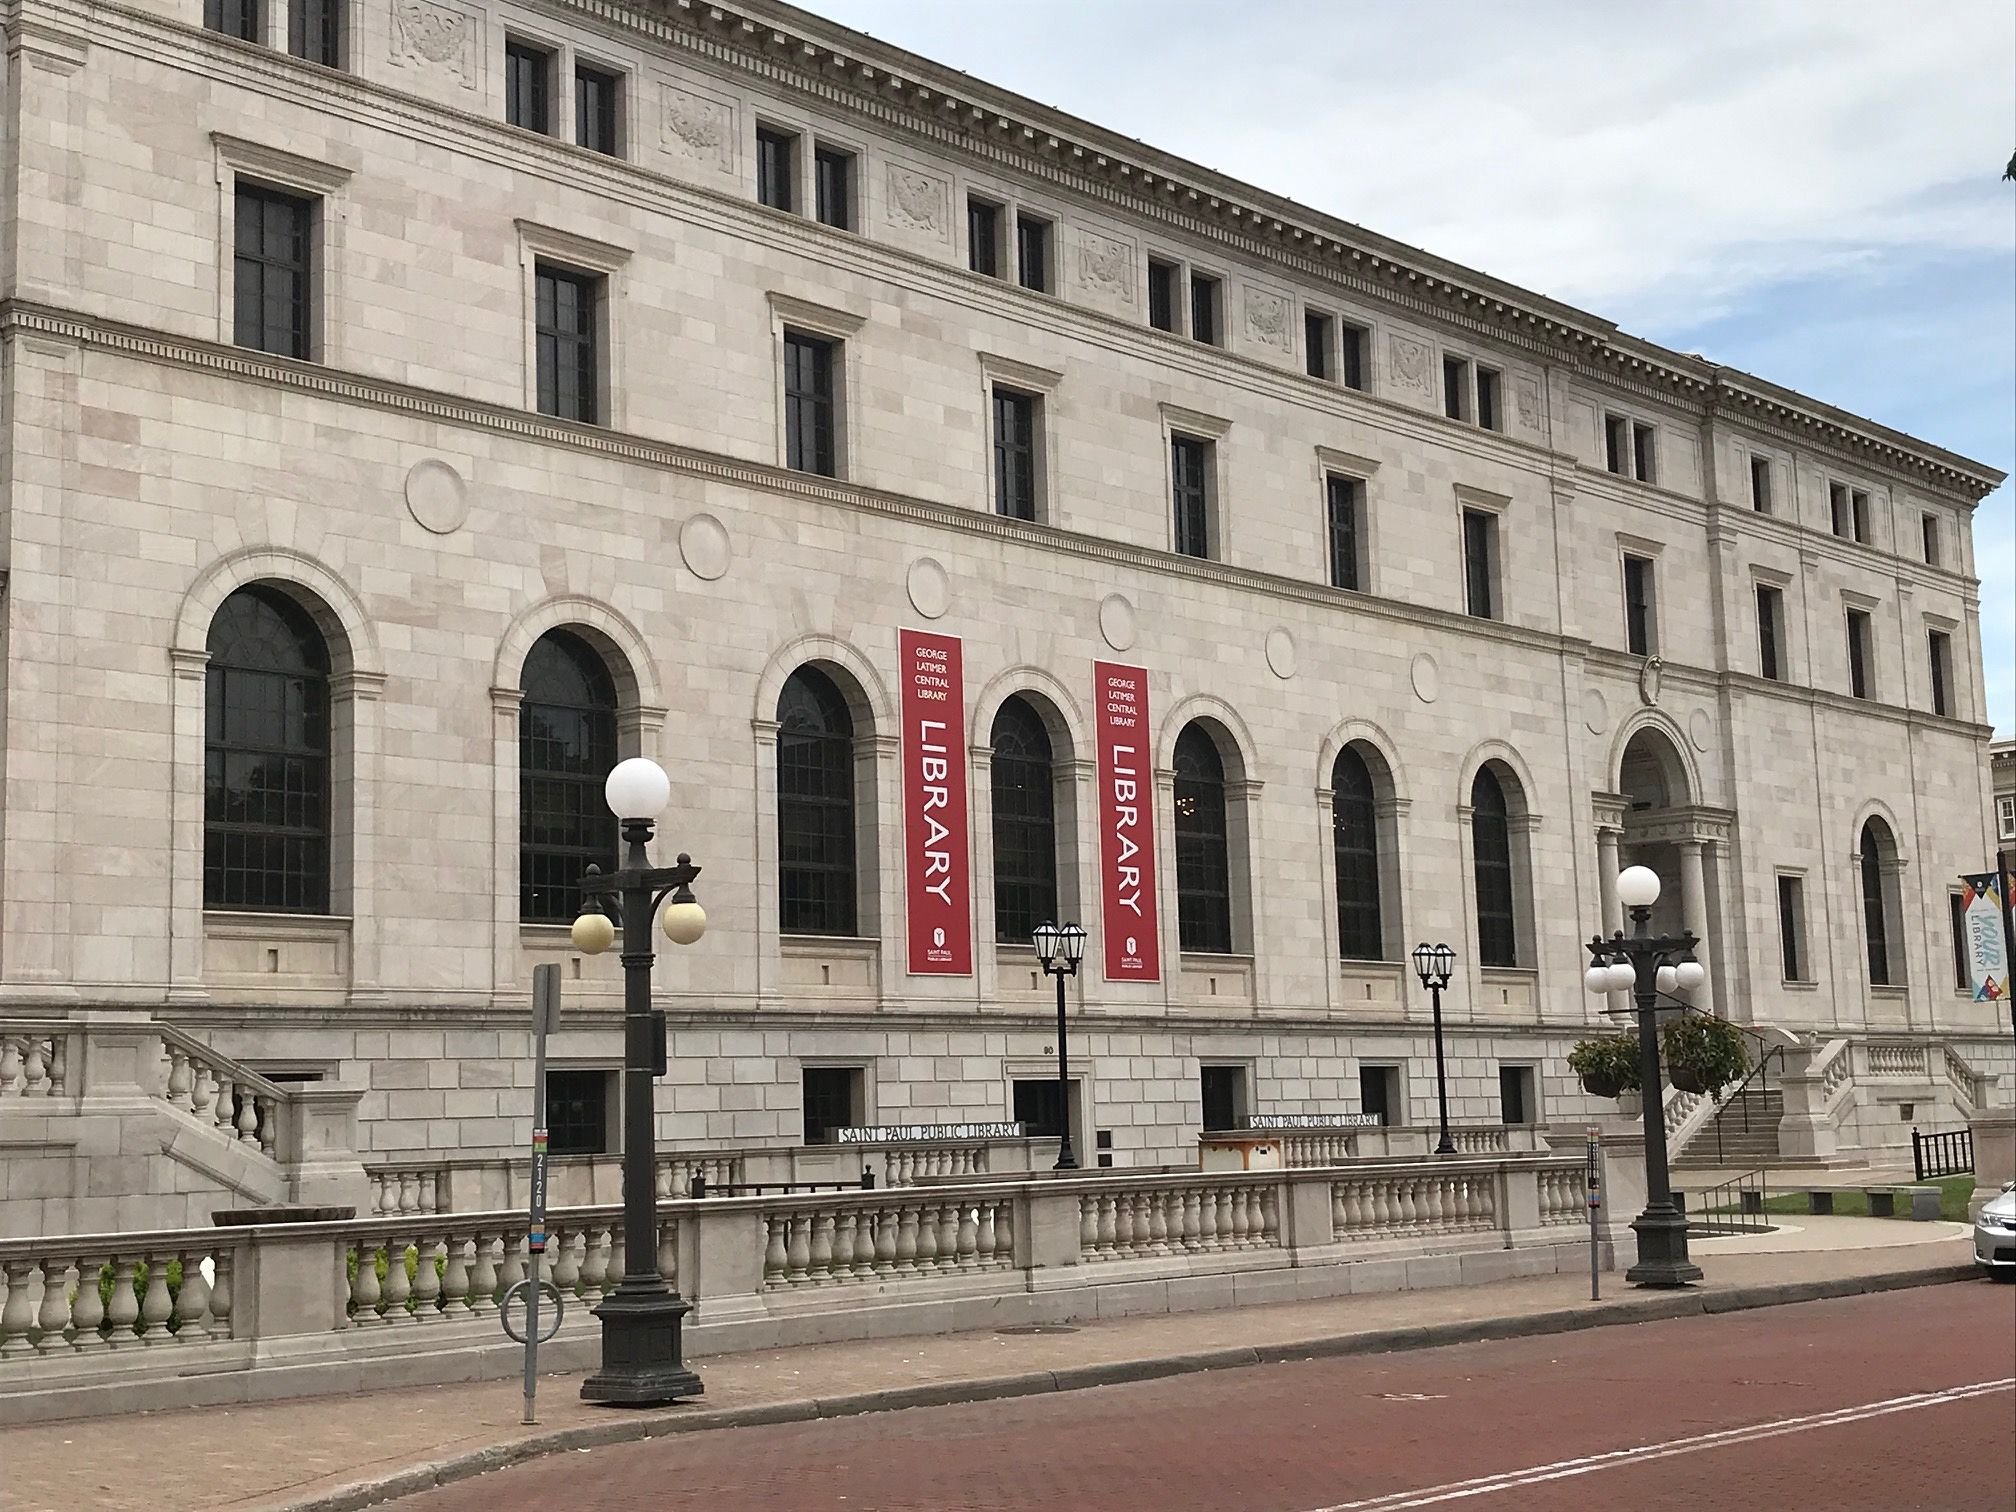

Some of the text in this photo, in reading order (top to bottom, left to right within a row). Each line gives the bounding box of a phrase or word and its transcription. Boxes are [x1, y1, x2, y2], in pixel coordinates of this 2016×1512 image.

[915, 647, 948, 661] GEORGE
[916, 661, 948, 674] LATIMER
[914, 674, 950, 689] CENTRAL
[1108, 677, 1136, 690] GEORGE
[917, 688, 948, 702] LIBRARY
[1108, 690, 1136, 702] LATIMER
[1107, 702, 1138, 716] CENTRAL
[1110, 716, 1136, 728] LIBRARY
[920, 719, 952, 907] LIBRARY
[1112, 744, 1142, 918] LIBRARY
[1971, 914, 1985, 967] LIBRARY
[1252, 1113, 1377, 1129] SAINT PAUL PUBLIC LIBRARY
[842, 1121, 1018, 1143] SAINT PAUL PUBLIC LIBRARY
[535, 1153, 544, 1208] 2120
